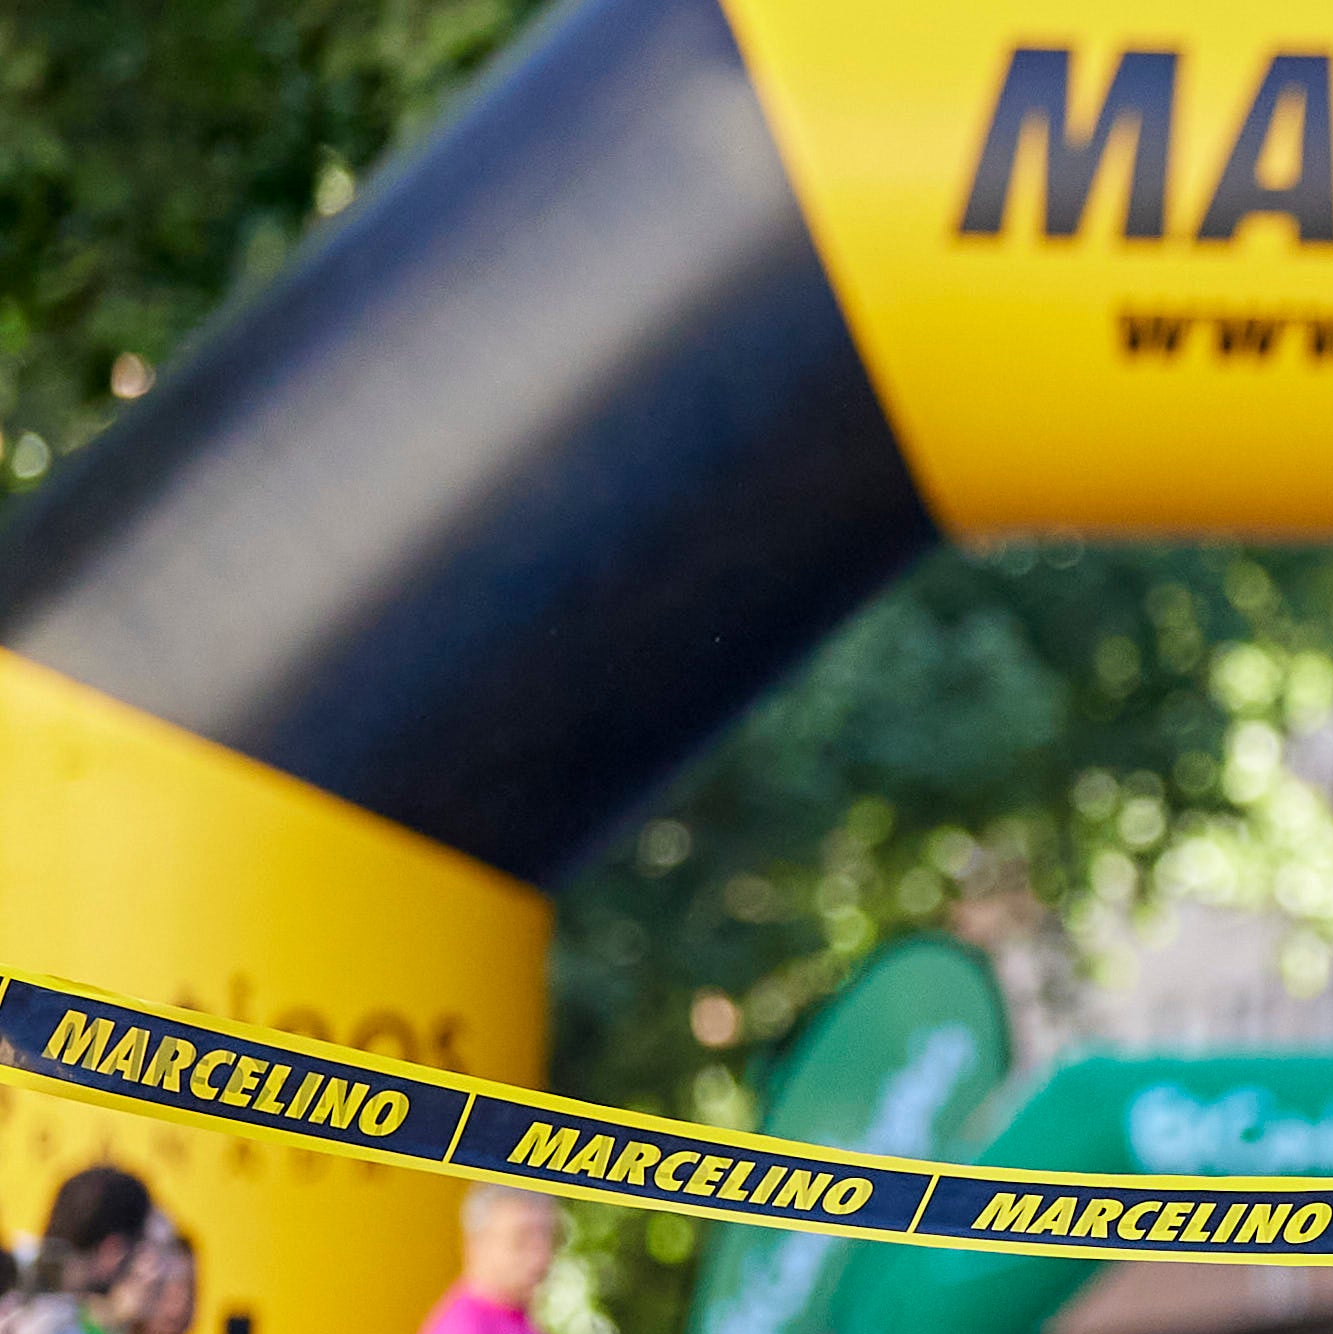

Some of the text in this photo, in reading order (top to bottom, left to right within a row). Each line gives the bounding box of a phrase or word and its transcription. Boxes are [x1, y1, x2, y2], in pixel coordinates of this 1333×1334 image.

[42, 1010, 410, 1137] MARCELINO
[507, 1122, 873, 1214] MARCELINO
[973, 1192, 1332, 1244] MARCELINO
